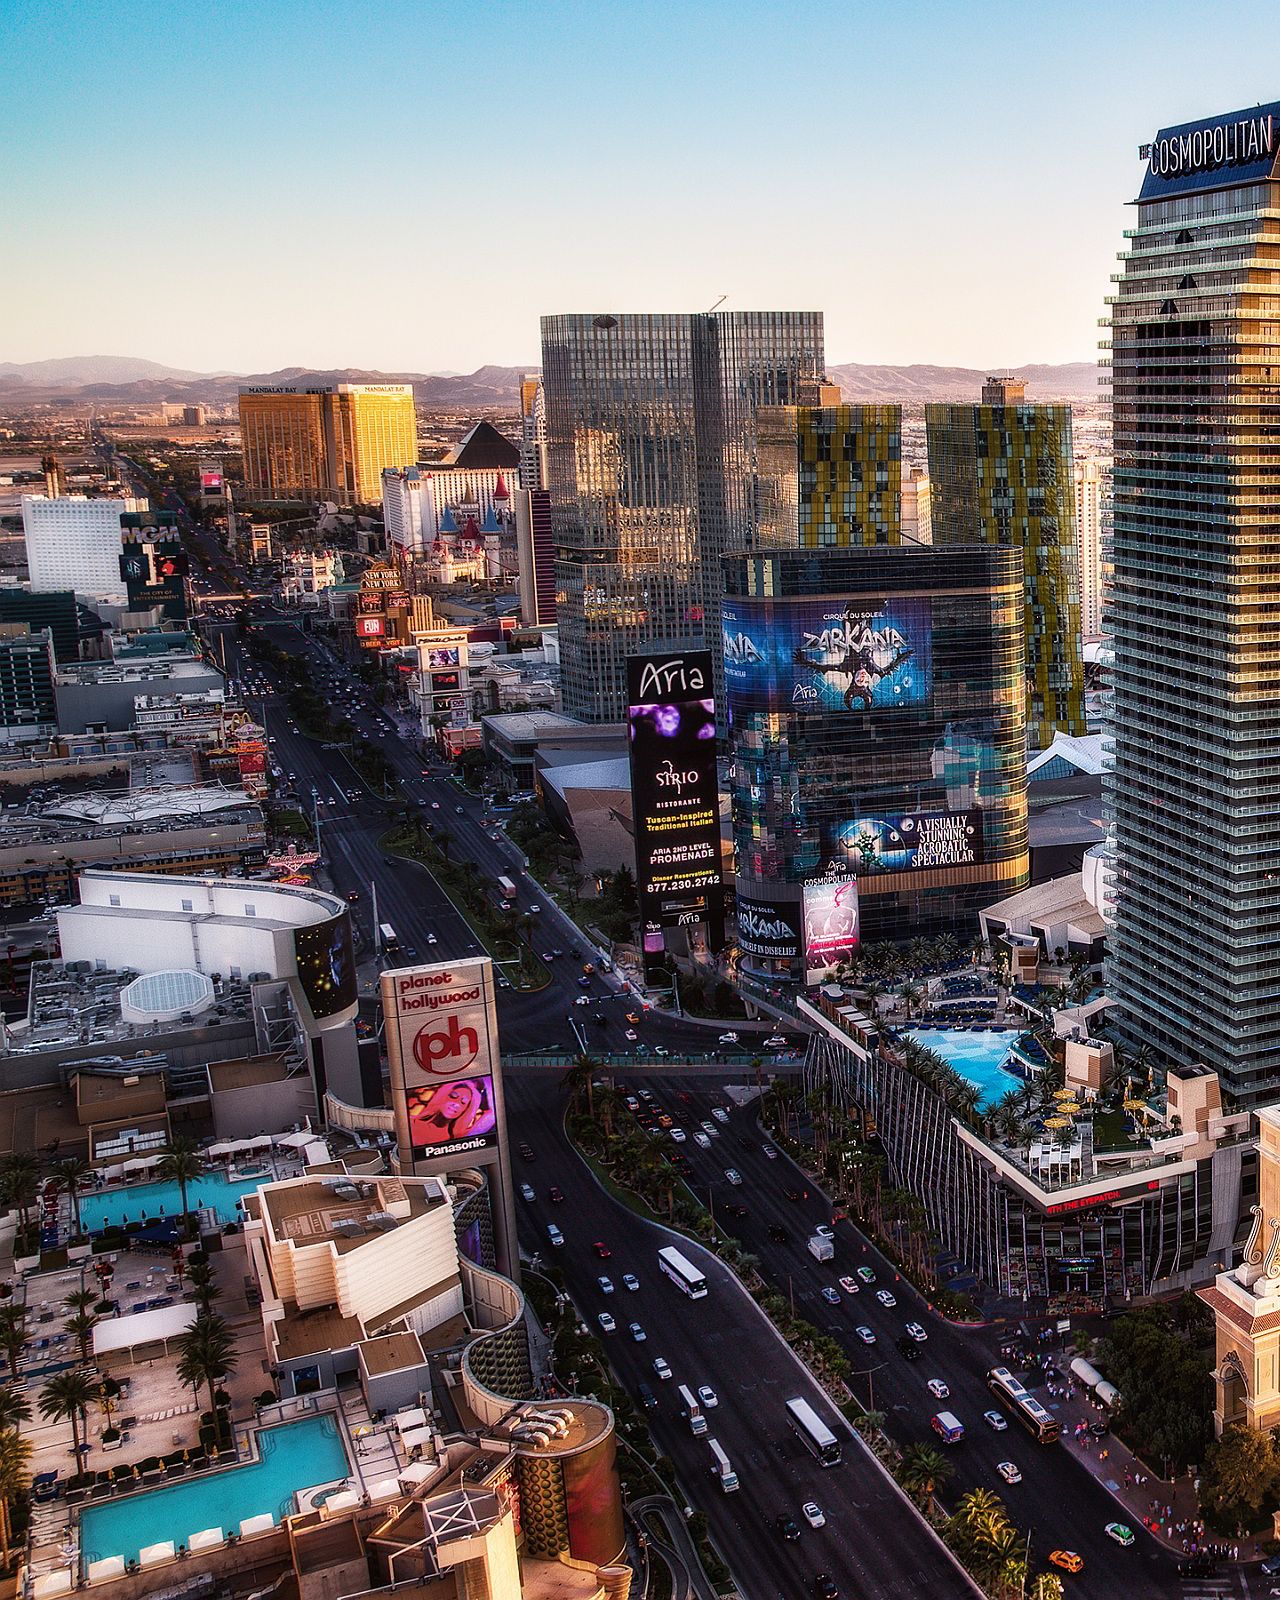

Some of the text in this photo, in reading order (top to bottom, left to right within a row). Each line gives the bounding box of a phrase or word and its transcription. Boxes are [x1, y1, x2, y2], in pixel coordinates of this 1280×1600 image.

[1138, 114, 1273, 176] THE COSMOPOLITAN
[121, 526, 181, 545] MGM
[364, 570, 399, 579] NEW YORK
[365, 579, 399, 588] NEW YORK
[823, 613, 849, 622] CIRQUE
[861, 611, 885, 619] SOLEIL
[364, 619, 380, 634] FUN
[801, 621, 908, 657] ZARKANA
[639, 660, 704, 698] Aria
[792, 683, 818, 702] Aria
[656, 768, 699, 793] SIRIO
[656, 798, 702, 809] RISTORANTE
[645, 809, 714, 825] Tuscan-Inspired
[646, 818, 715, 832] Traditional Italian
[916, 815, 968, 832] A VISUALLY
[920, 827, 965, 844] STUNNING
[652, 842, 711, 856] ARIA 2ND LEVEL
[917, 838, 969, 856] ACROBATIC
[650, 848, 715, 865] PROMENADE
[912, 849, 975, 868] SPECTACULAR
[828, 860, 847, 872] Aria
[647, 875, 720, 893] 877.230.2742
[652, 868, 716, 883] Dinner Reservations:
[804, 873, 857, 888] COSMOPOLITAN
[678, 912, 700, 926] Aria
[765, 945, 797, 956] DISBELIEF
[400, 971, 453, 995] planet
[402, 986, 481, 1011] hollywood
[418, 1014, 480, 1074] ph
[425, 1137, 487, 1158] Panasonic
[1063, 1199, 1079, 1210] THE
